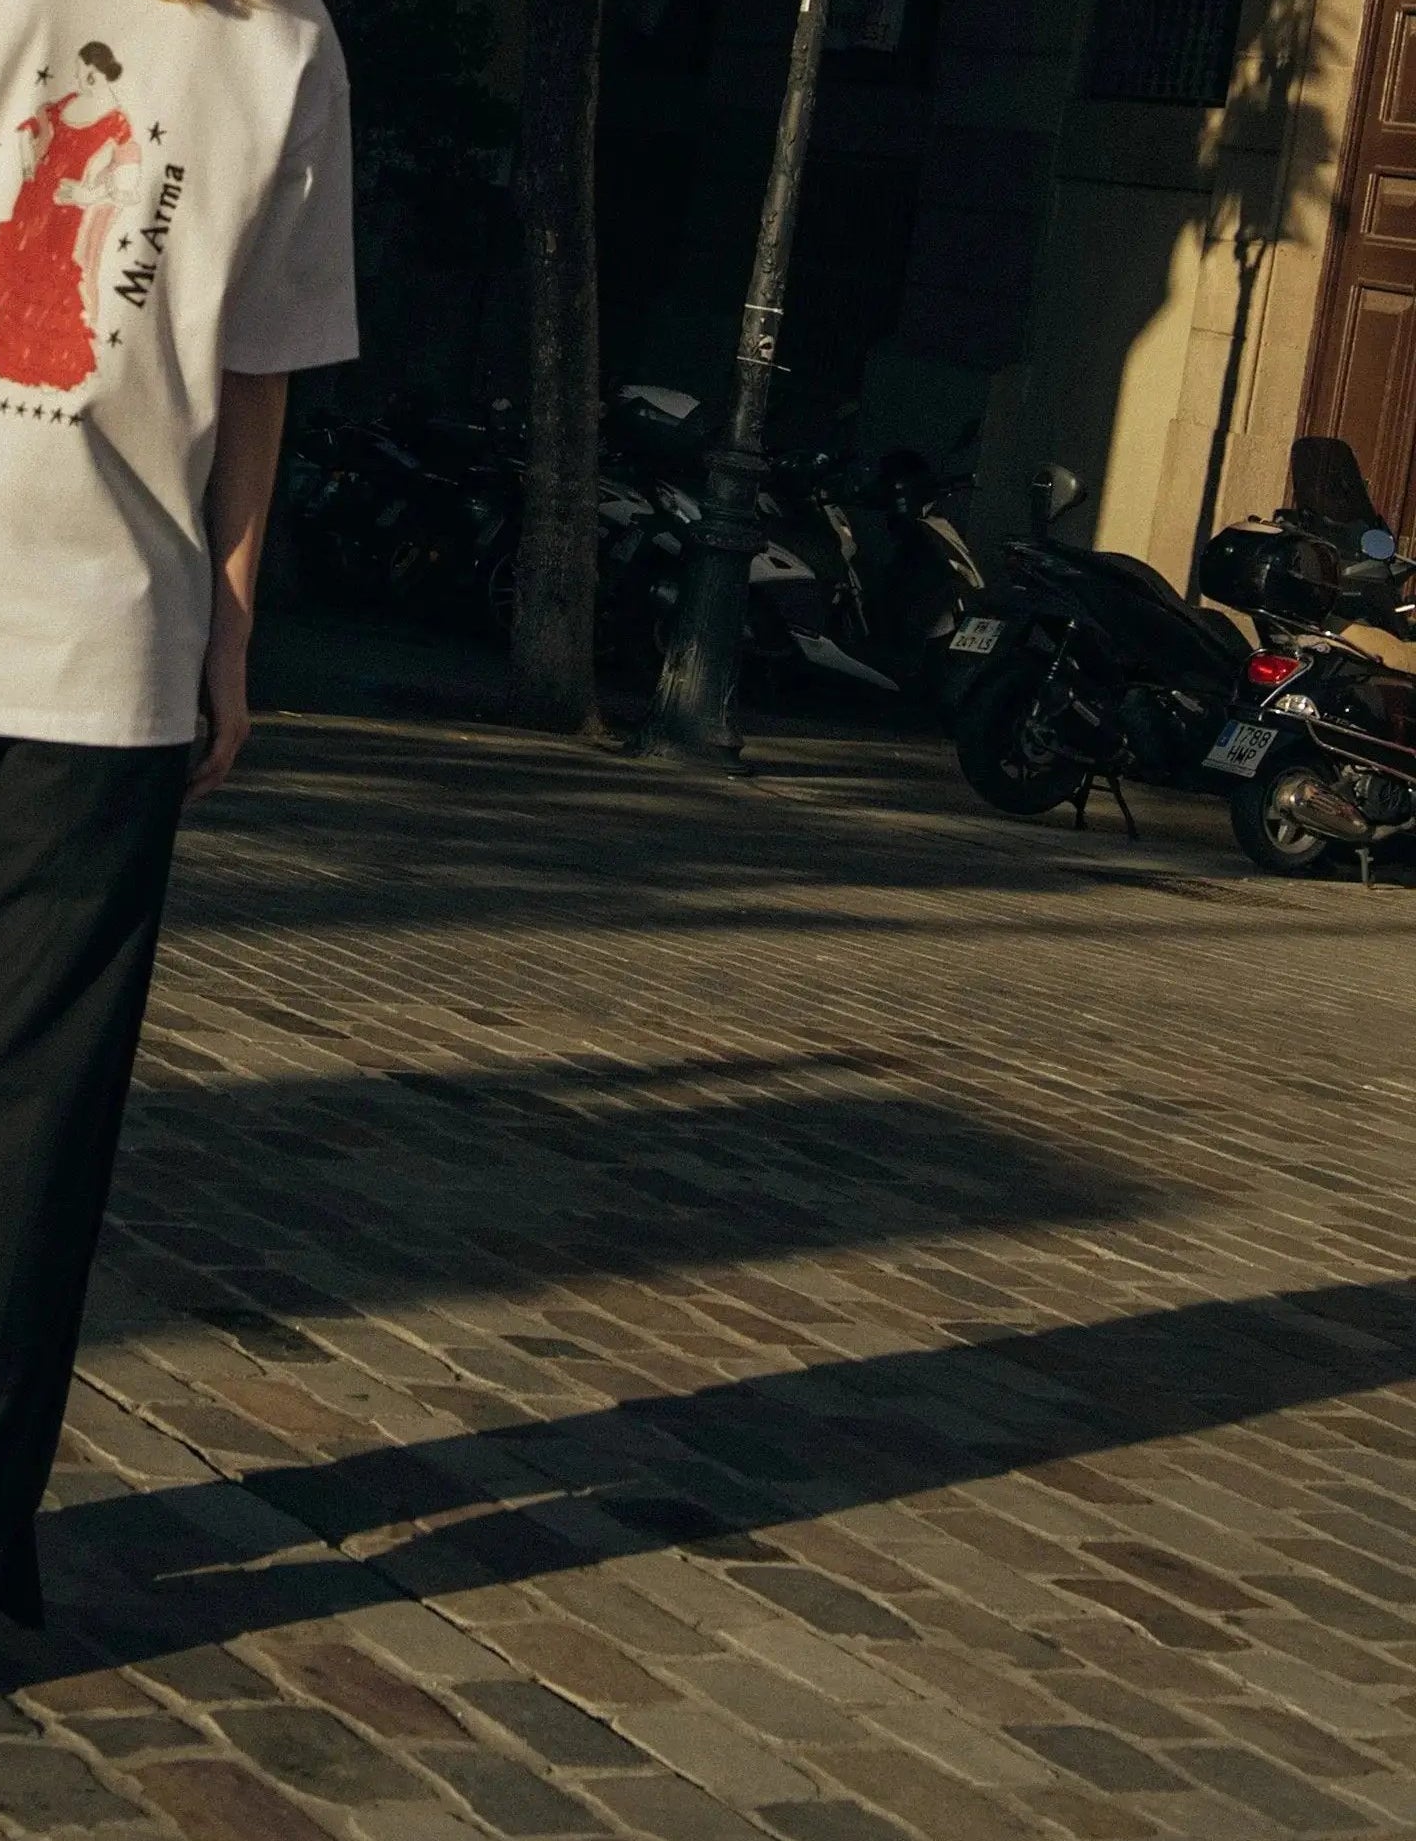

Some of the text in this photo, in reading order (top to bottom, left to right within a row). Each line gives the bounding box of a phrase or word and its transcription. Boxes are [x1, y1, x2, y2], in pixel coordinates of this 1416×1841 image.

[114, 163, 185, 309] Mi Arma
[1234, 726, 1272, 748] 1788
